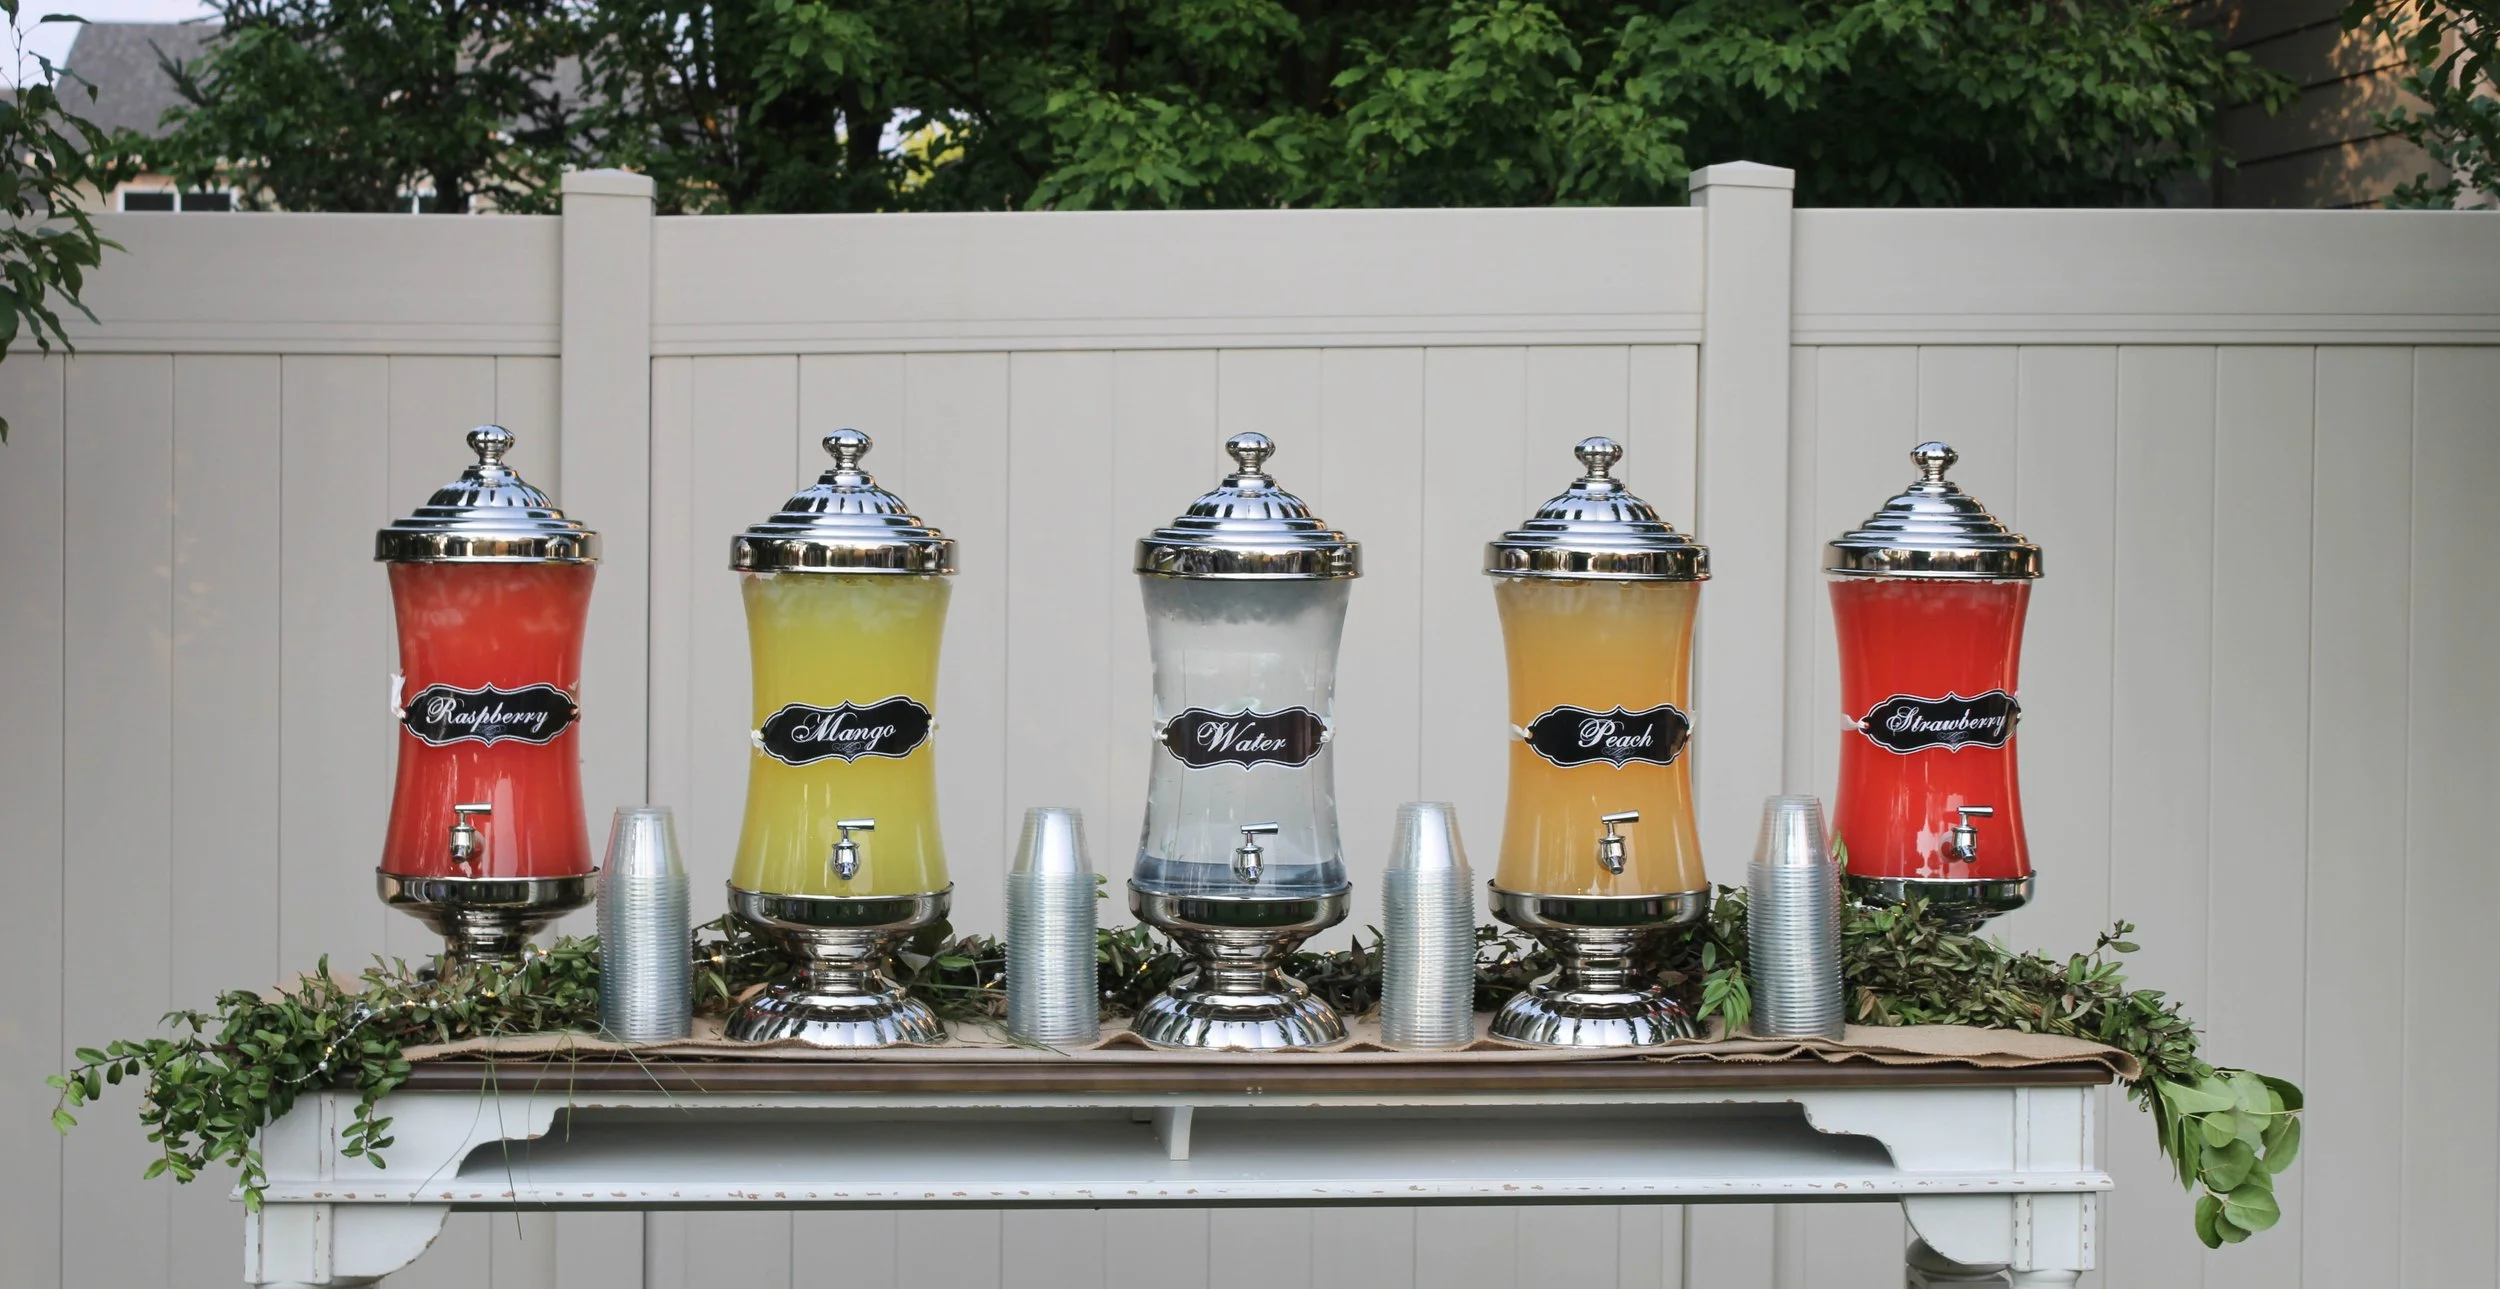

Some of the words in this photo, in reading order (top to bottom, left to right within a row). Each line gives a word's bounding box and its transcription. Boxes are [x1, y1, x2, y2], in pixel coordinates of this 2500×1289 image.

[426, 696, 548, 734] Raspberry
[791, 712, 896, 750] Mango
[1886, 705, 2006, 737] Strawberry
[1197, 721, 1286, 752] Water
[1578, 717, 1653, 748] Peach
